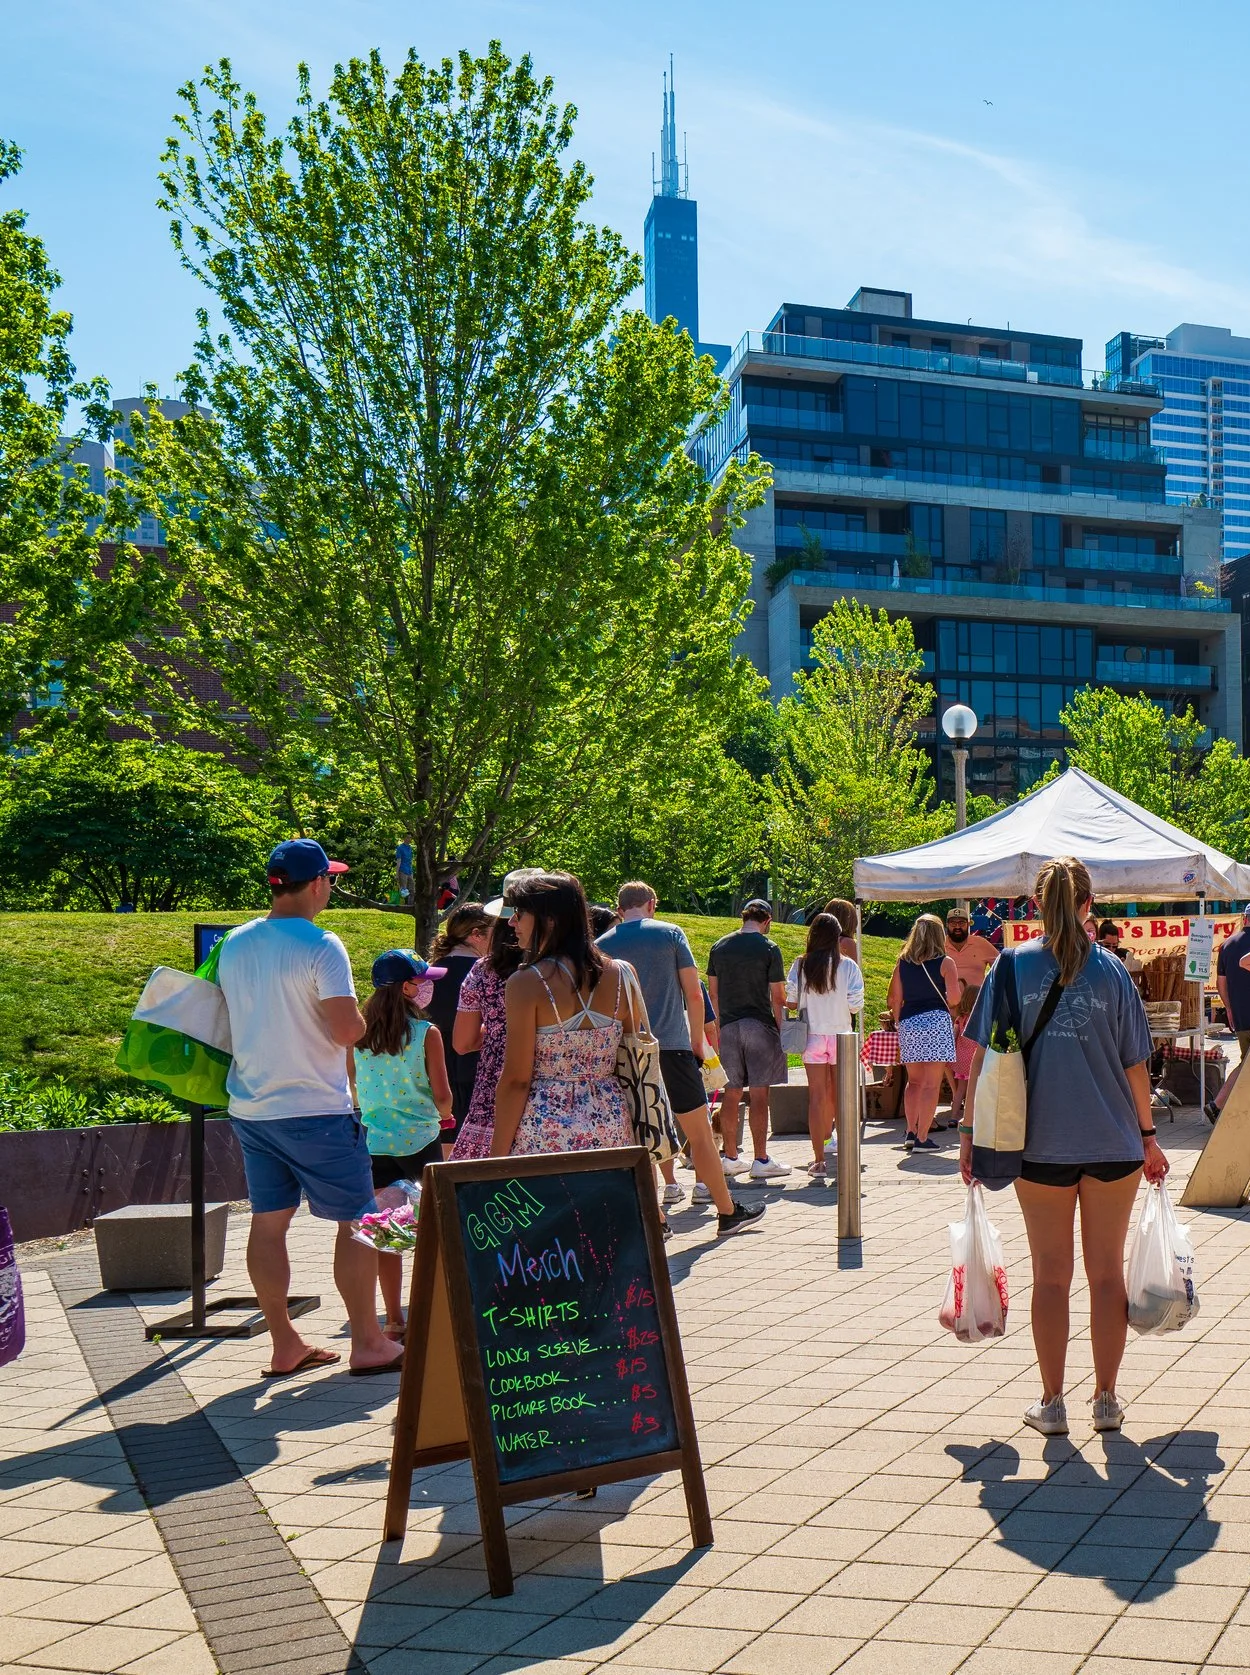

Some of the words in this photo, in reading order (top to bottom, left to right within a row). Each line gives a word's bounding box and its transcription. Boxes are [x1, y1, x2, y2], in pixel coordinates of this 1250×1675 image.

[1150, 920, 1236, 938] Bary
[467, 1179, 545, 1250] GCM
[497, 1238, 584, 1287] Merch
[625, 1284, 654, 1309] $15
[486, 1348, 530, 1368] LONG
[626, 1326, 659, 1350] $25
[615, 1357, 648, 1380] $15
[491, 1400, 547, 1421] PICTURE
[631, 1384, 657, 1402] $5
[631, 1412, 660, 1434] $3
